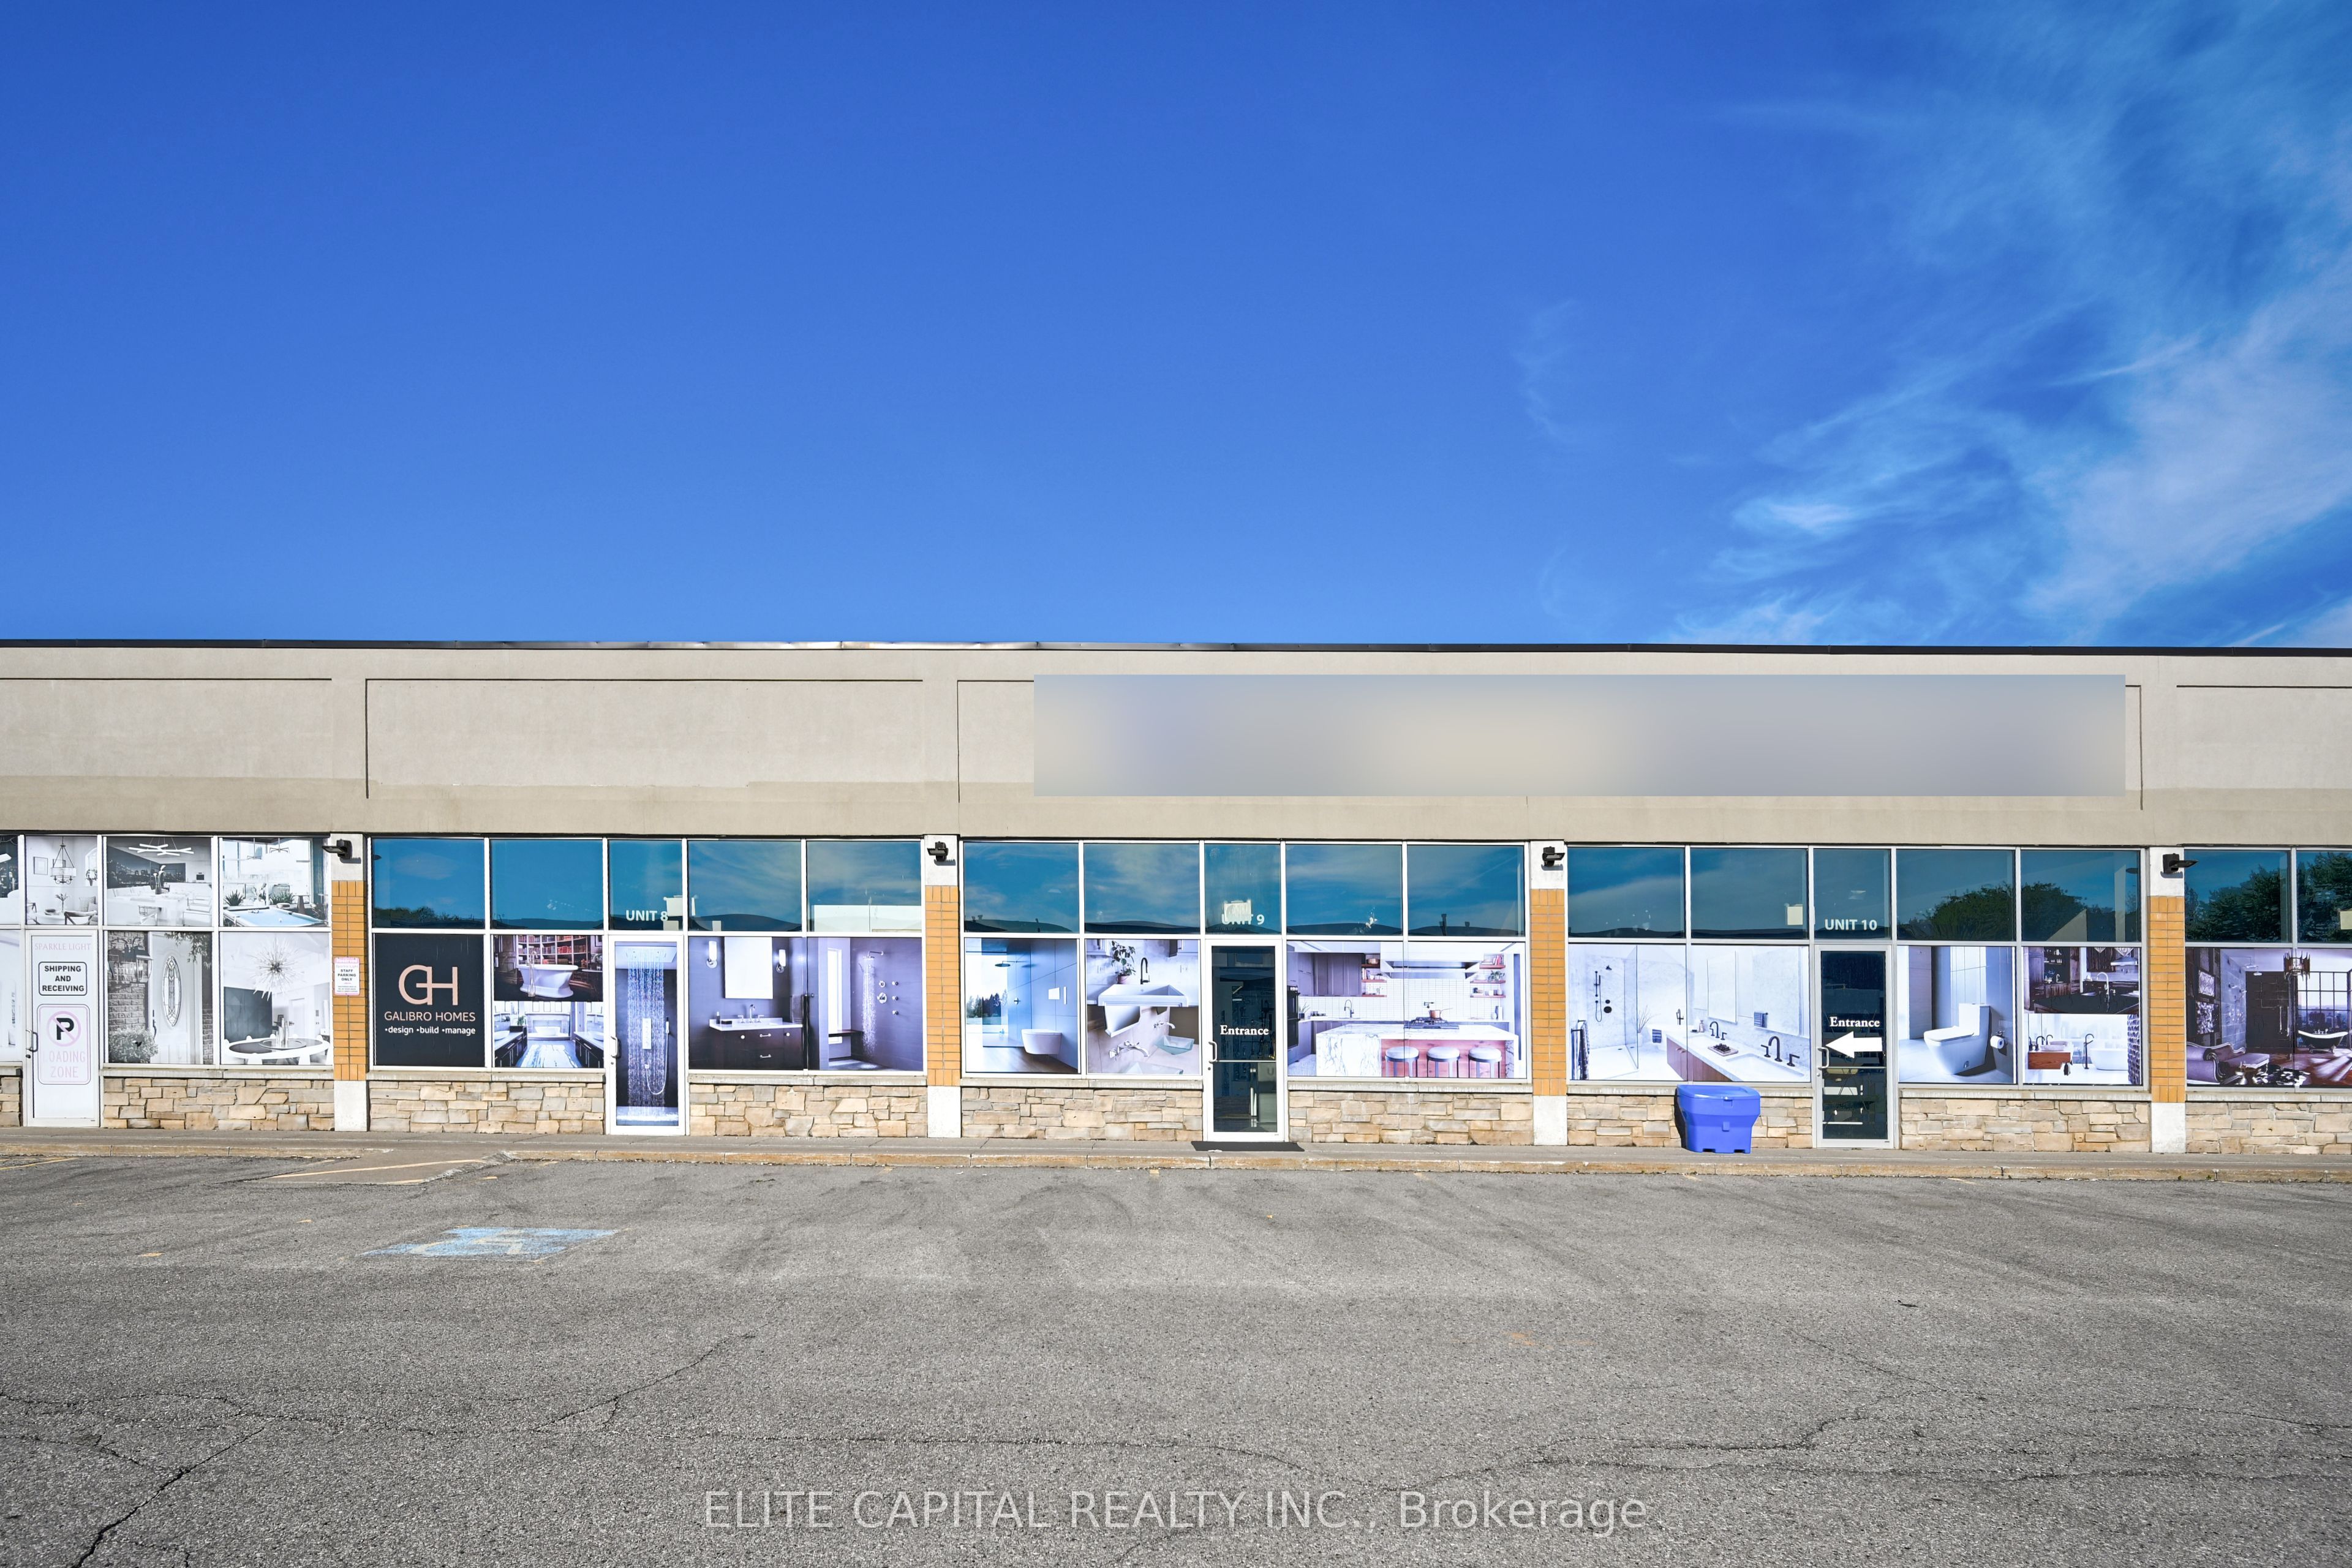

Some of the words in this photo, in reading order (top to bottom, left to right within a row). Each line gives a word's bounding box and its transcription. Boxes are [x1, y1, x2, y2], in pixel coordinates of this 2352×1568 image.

[625, 910, 657, 921] UNIT
[660, 911, 668, 922] 8
[1221, 913, 1253, 925] UT
[1256, 914, 1265, 925] 9
[1825, 919, 1858, 930] UNIT
[1861, 919, 1877, 930] 10
[384, 1011, 432, 1021] GALIBRO
[435, 1012, 476, 1022] HOMES
[1830, 1016, 1880, 1027] Entrance
[1219, 1025, 1269, 1035] Entrance
[50, 1066, 78, 1078] ZONE
